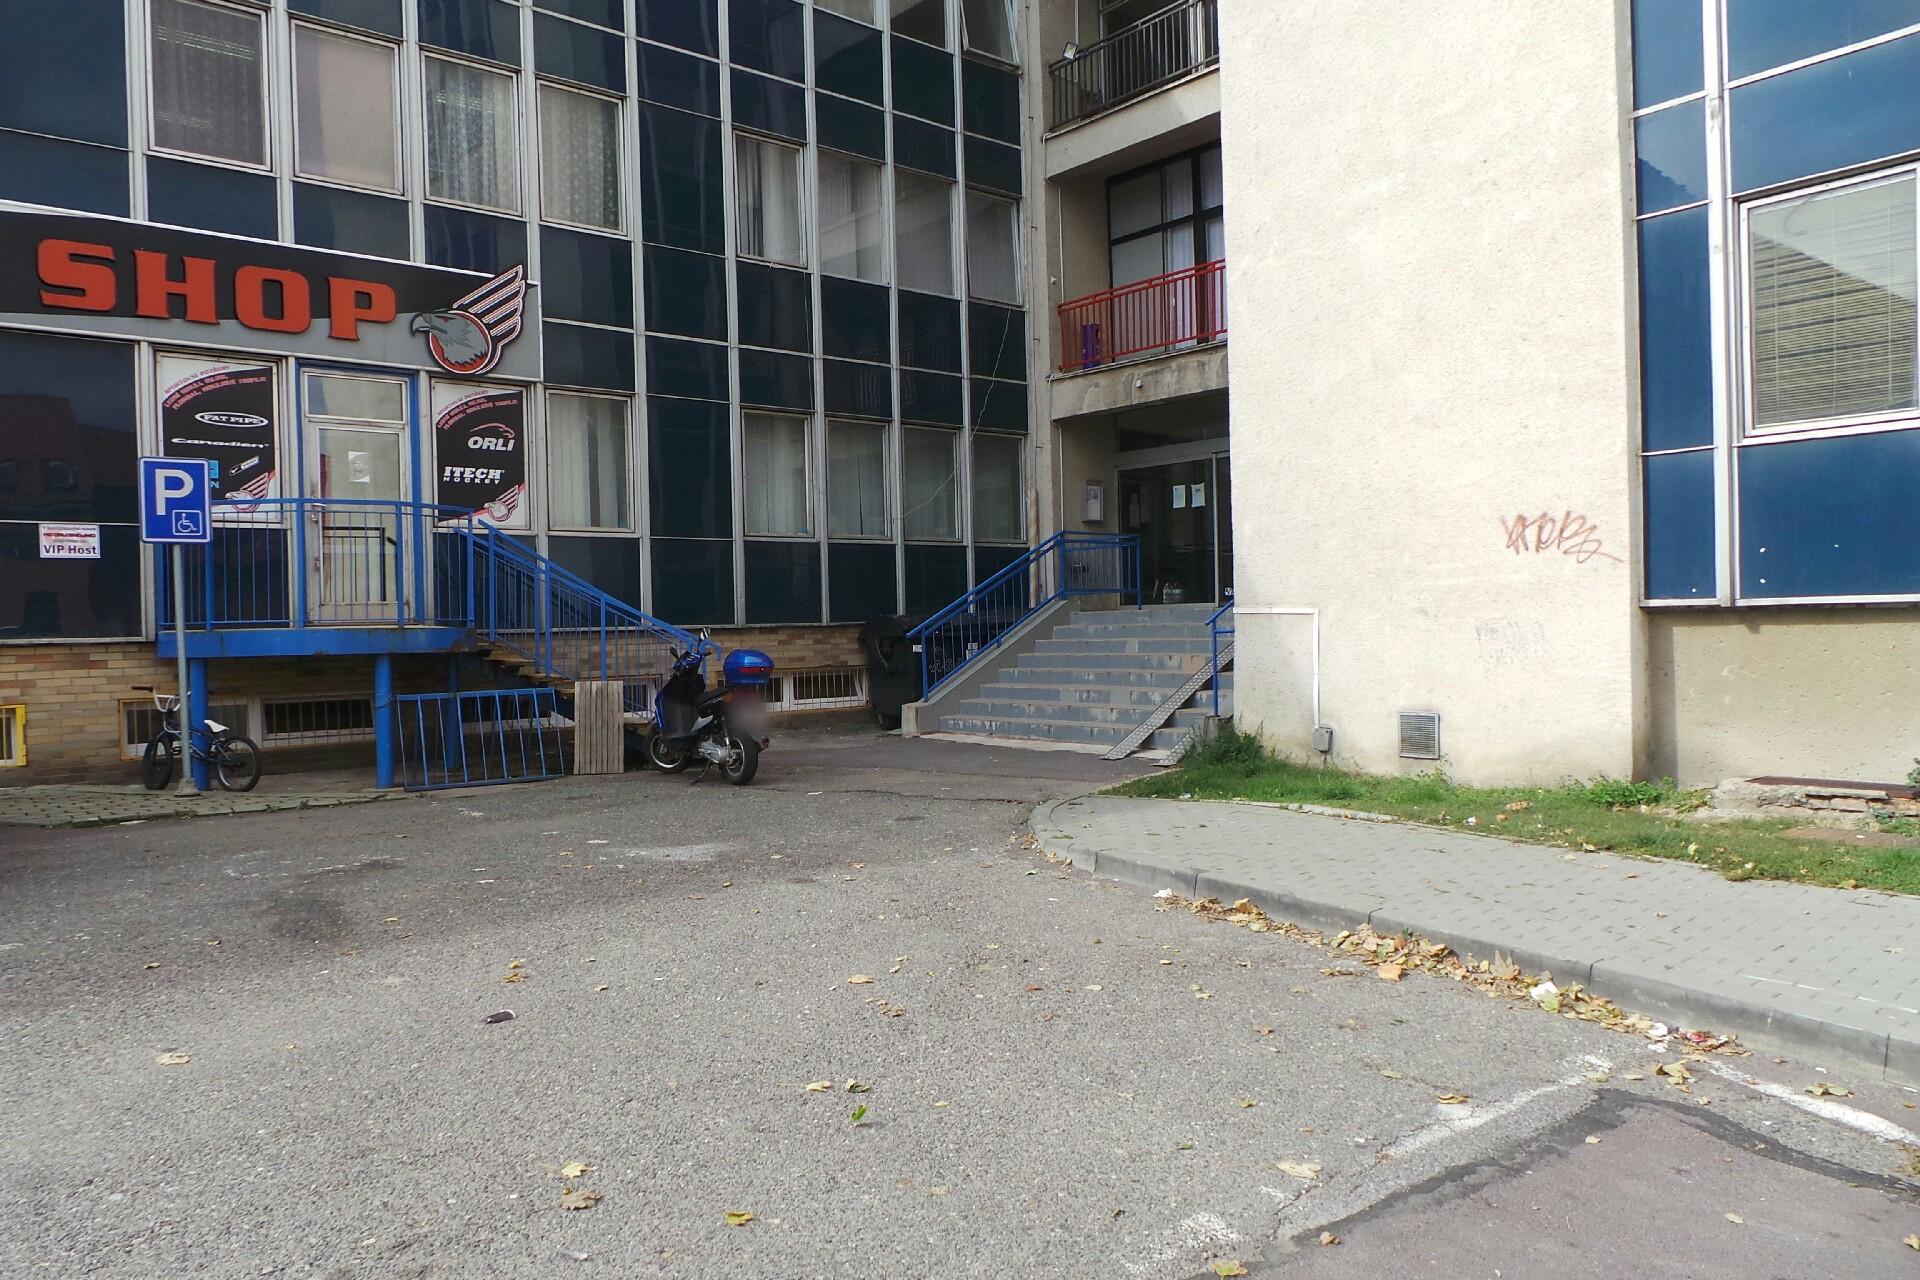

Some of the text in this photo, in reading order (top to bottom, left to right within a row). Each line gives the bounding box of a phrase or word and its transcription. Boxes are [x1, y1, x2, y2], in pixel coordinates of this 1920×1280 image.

[37, 238, 397, 341] SHOP
[229, 416, 262, 425] PIPE
[468, 436, 515, 451] ORLI
[444, 466, 502, 479] ITECH
[155, 468, 194, 516] P
[43, 544, 97, 554] VIP Host
